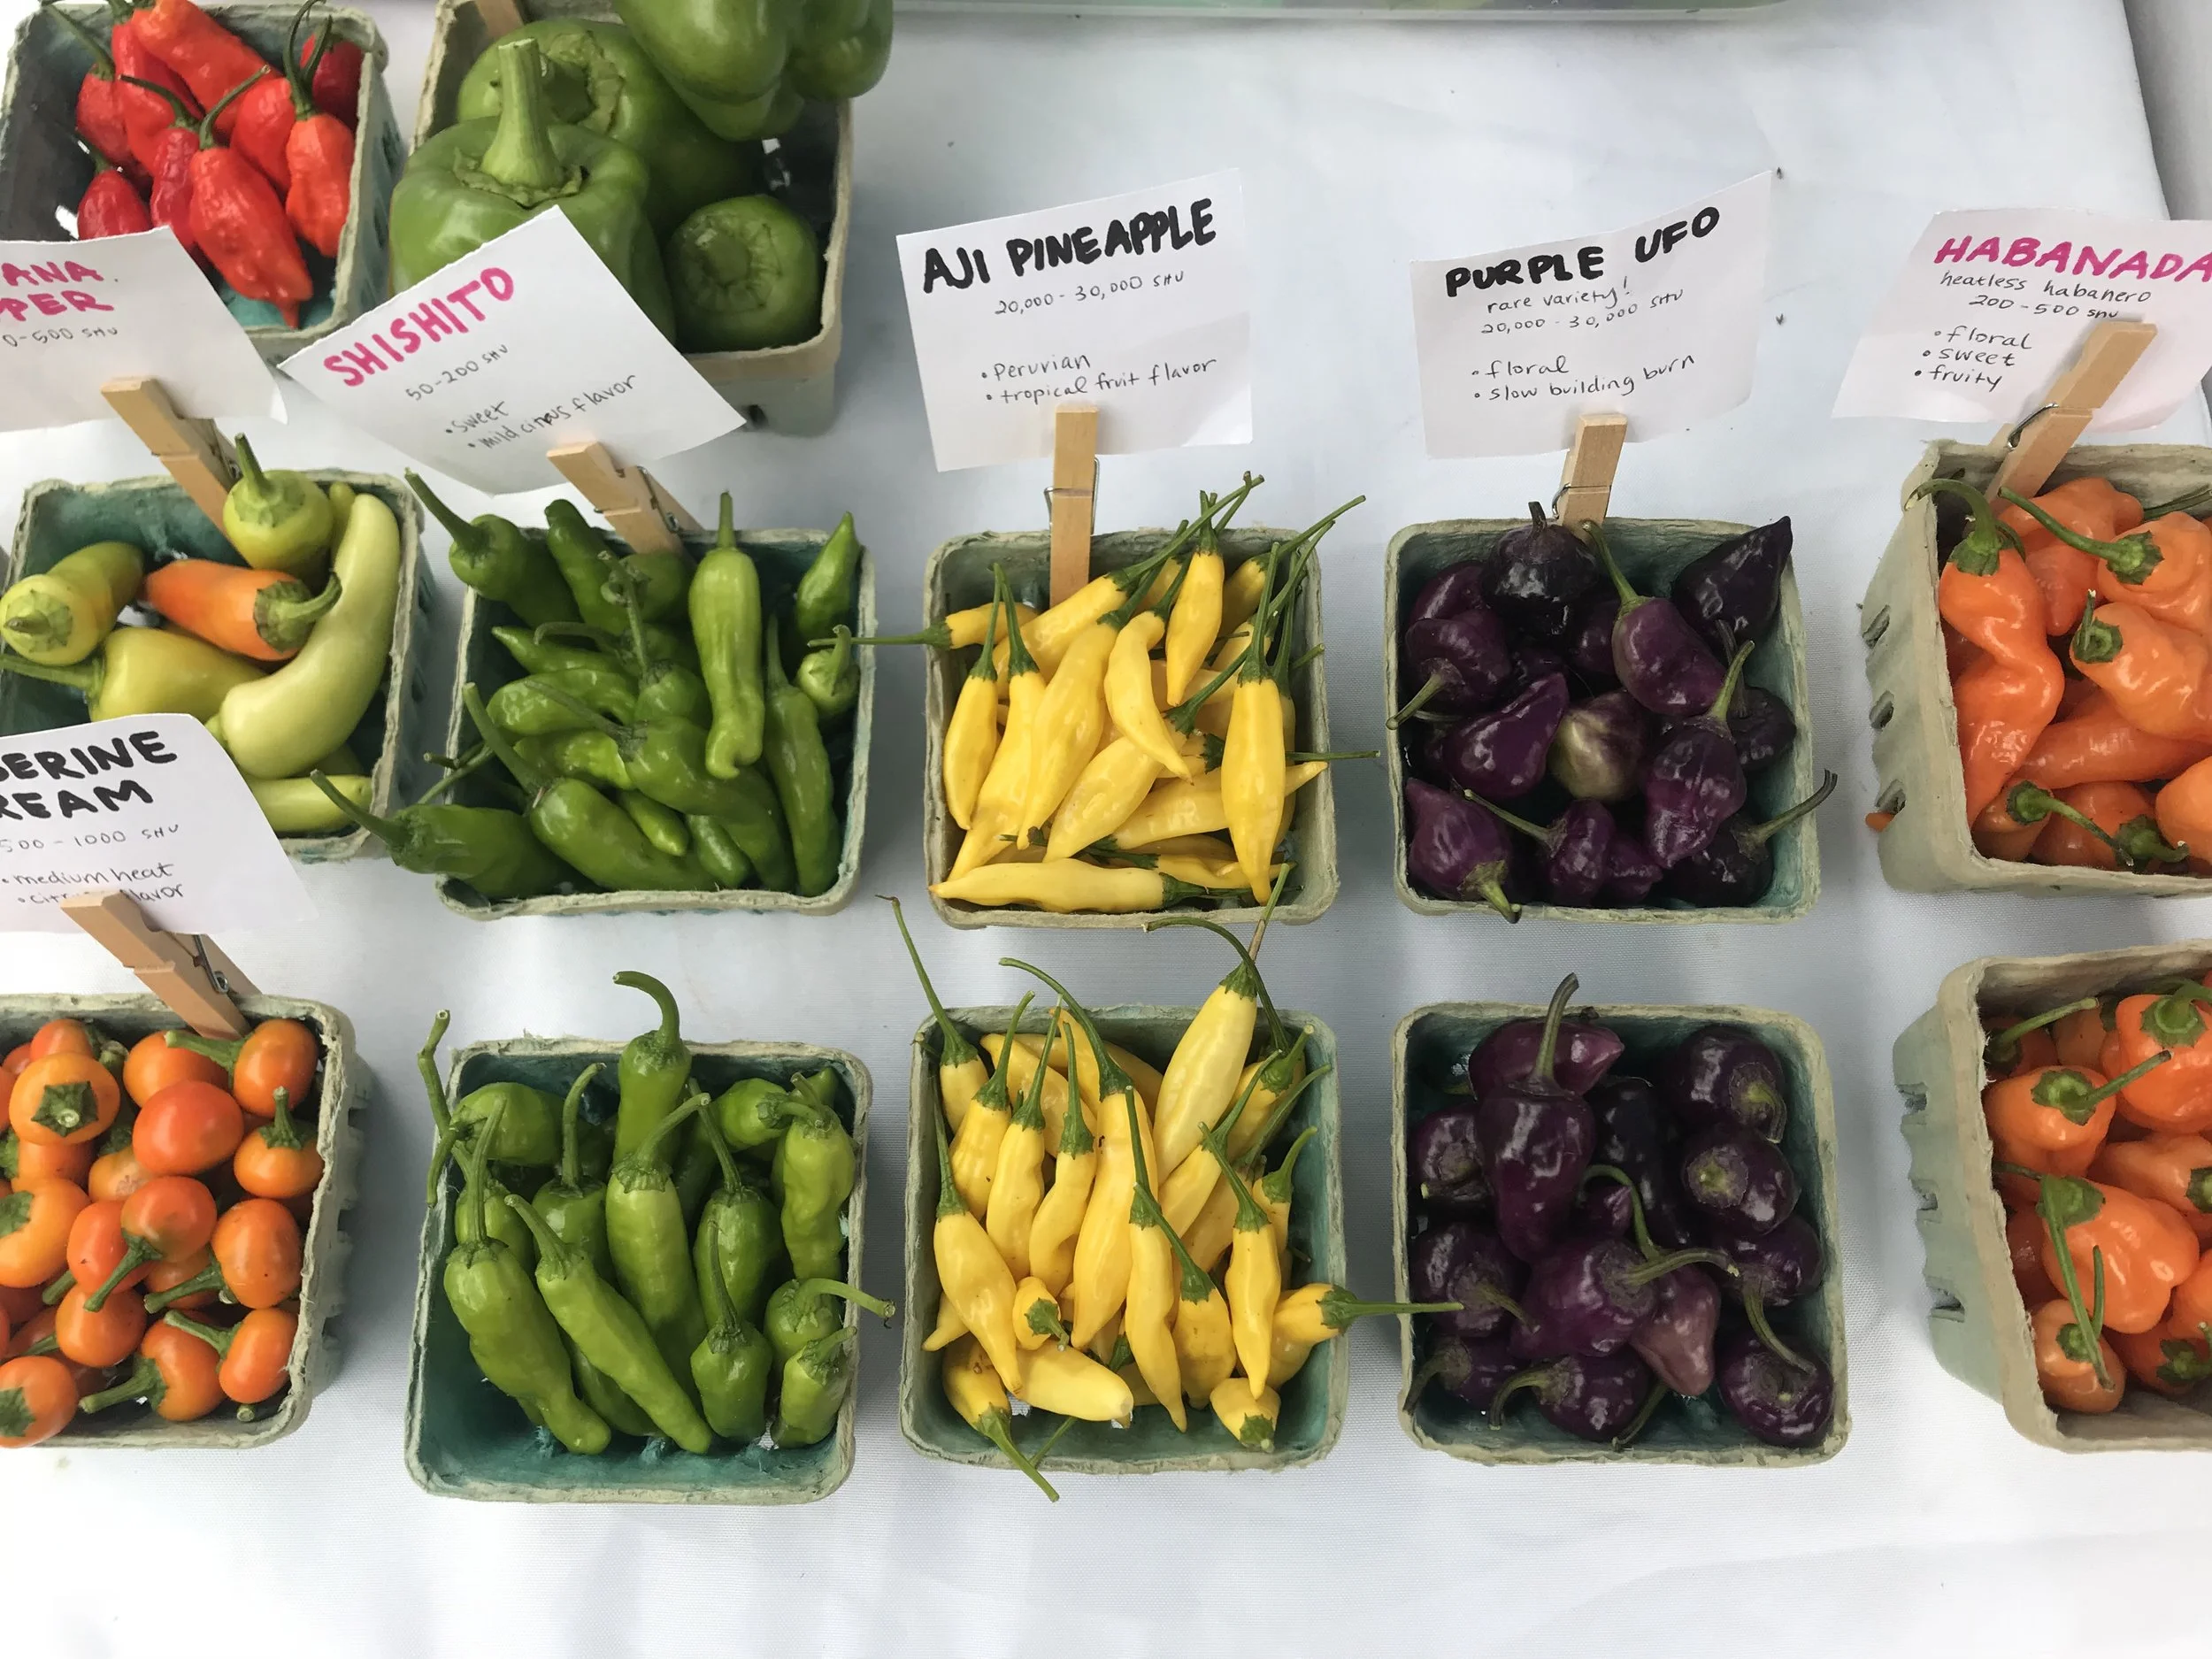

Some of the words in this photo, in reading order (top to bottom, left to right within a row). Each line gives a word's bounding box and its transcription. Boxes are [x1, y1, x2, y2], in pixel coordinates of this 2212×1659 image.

[923, 247, 990, 294] AJI
[1006, 197, 1217, 276] PINEAPPLE
[1446, 246, 1604, 297] PURPLE
[1634, 206, 1720, 263] UFO
[1933, 234, 2212, 283] HABANADA
[1153, 271, 1184, 288] SHU
[1939, 270, 2027, 291] heatless
[2043, 280, 2152, 303] habanero
[1487, 296, 1532, 313] rare
[1650, 288, 1684, 308] SHU
[323, 266, 515, 387] SHISHITO
[1946, 325, 2032, 349] floral
[481, 344, 509, 364] SHU
[1486, 355, 1570, 377] floral
[1938, 348, 2016, 366] sweet
[1001, 376, 1088, 405] tropical
[1095, 373, 1141, 391] fruit
[1148, 358, 1217, 387] flavor
[1549, 376, 1636, 397] building
[1643, 354, 1695, 381] burn
[1929, 364, 2003, 393] fruity
[571, 374, 636, 413] flavor
[0, 731, 178, 782] ERINE
[74, 830, 127, 848] 1000
[142, 824, 180, 840] SHU
[13, 870, 110, 886] medium
[110, 861, 175, 882] heat
